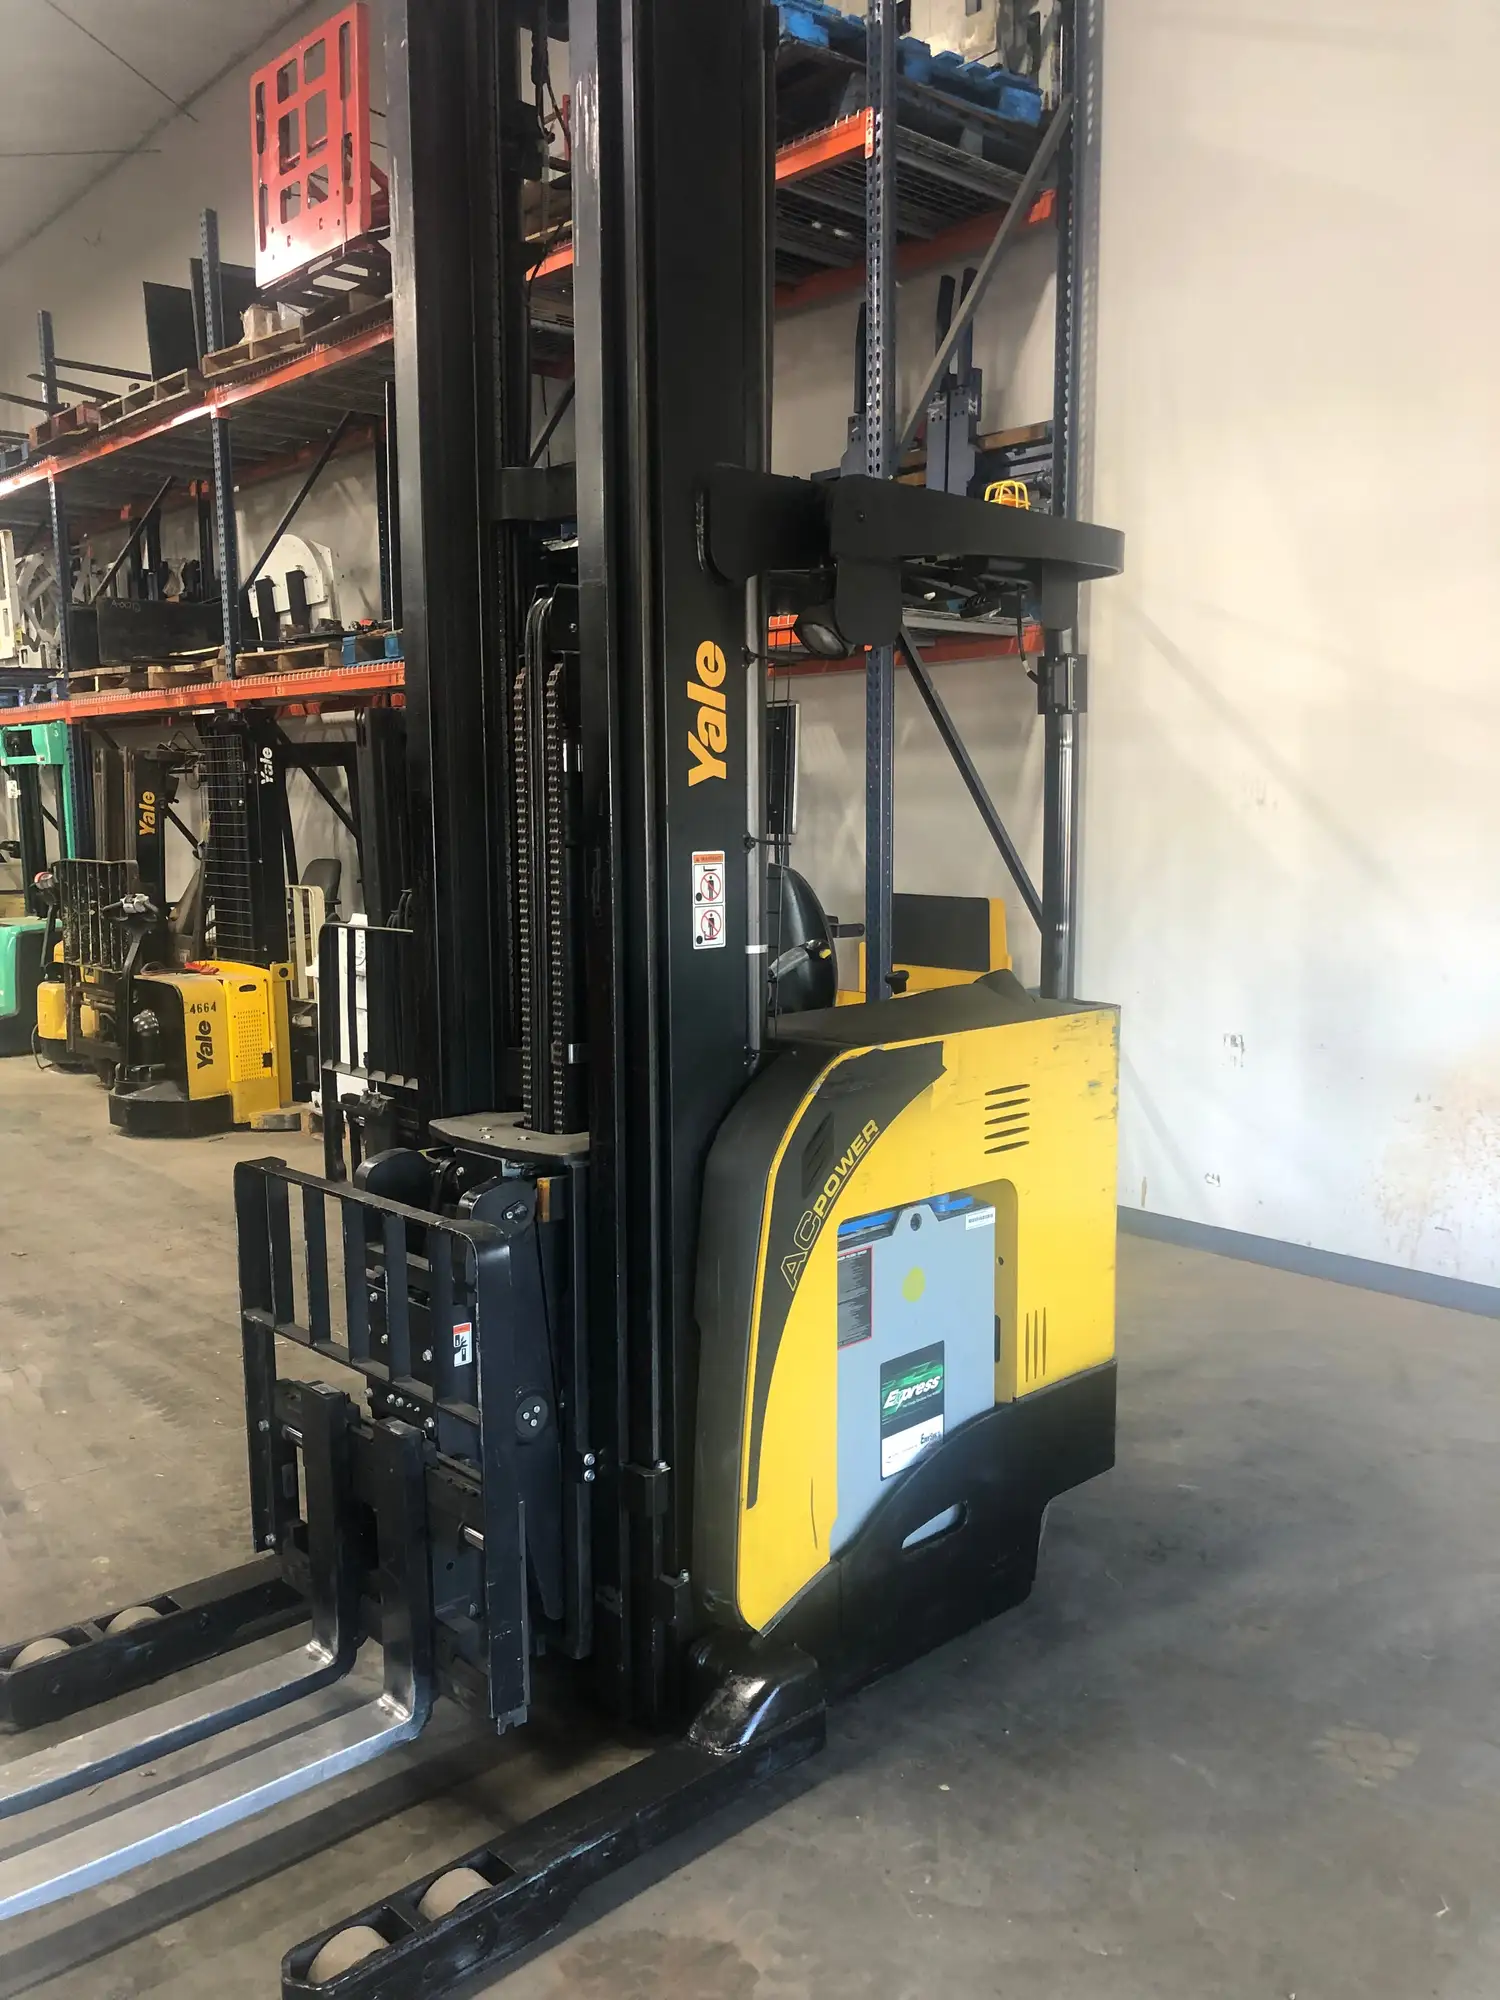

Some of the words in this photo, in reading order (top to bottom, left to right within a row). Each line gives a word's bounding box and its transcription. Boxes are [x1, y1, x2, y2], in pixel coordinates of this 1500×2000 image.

[687, 640, 728, 787] Yale
[260, 746, 274, 785] Yale
[138, 790, 156, 836] Yale
[189, 1001, 217, 1015] 4664
[195, 1020, 214, 1070] Yale
[882, 1375, 942, 1412] Express
